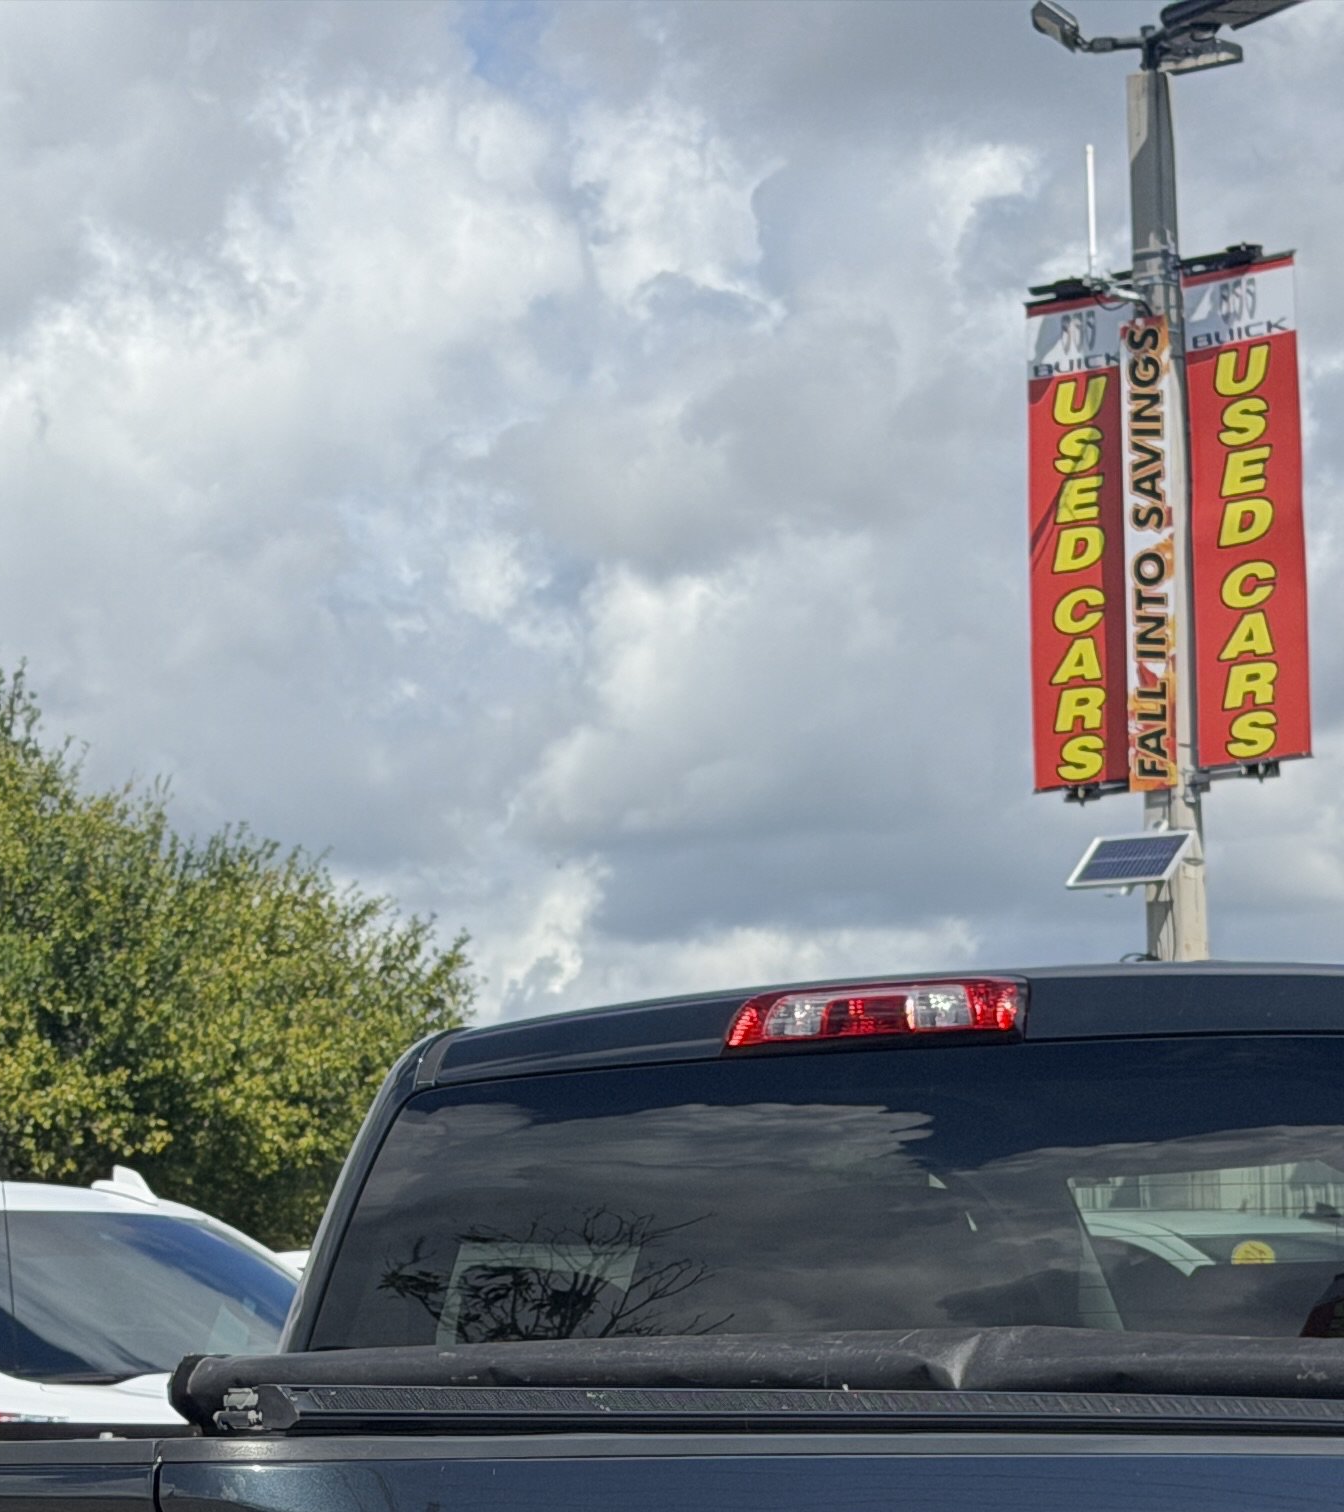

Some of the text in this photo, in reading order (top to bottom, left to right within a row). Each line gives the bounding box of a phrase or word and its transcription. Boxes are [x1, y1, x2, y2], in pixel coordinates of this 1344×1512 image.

[1193, 317, 1289, 349] BUICK
[1050, 374, 1108, 783] USED CARS
[1128, 327, 1169, 780] FALL INTO SAVINGS
[1213, 343, 1278, 760] USED CARS
